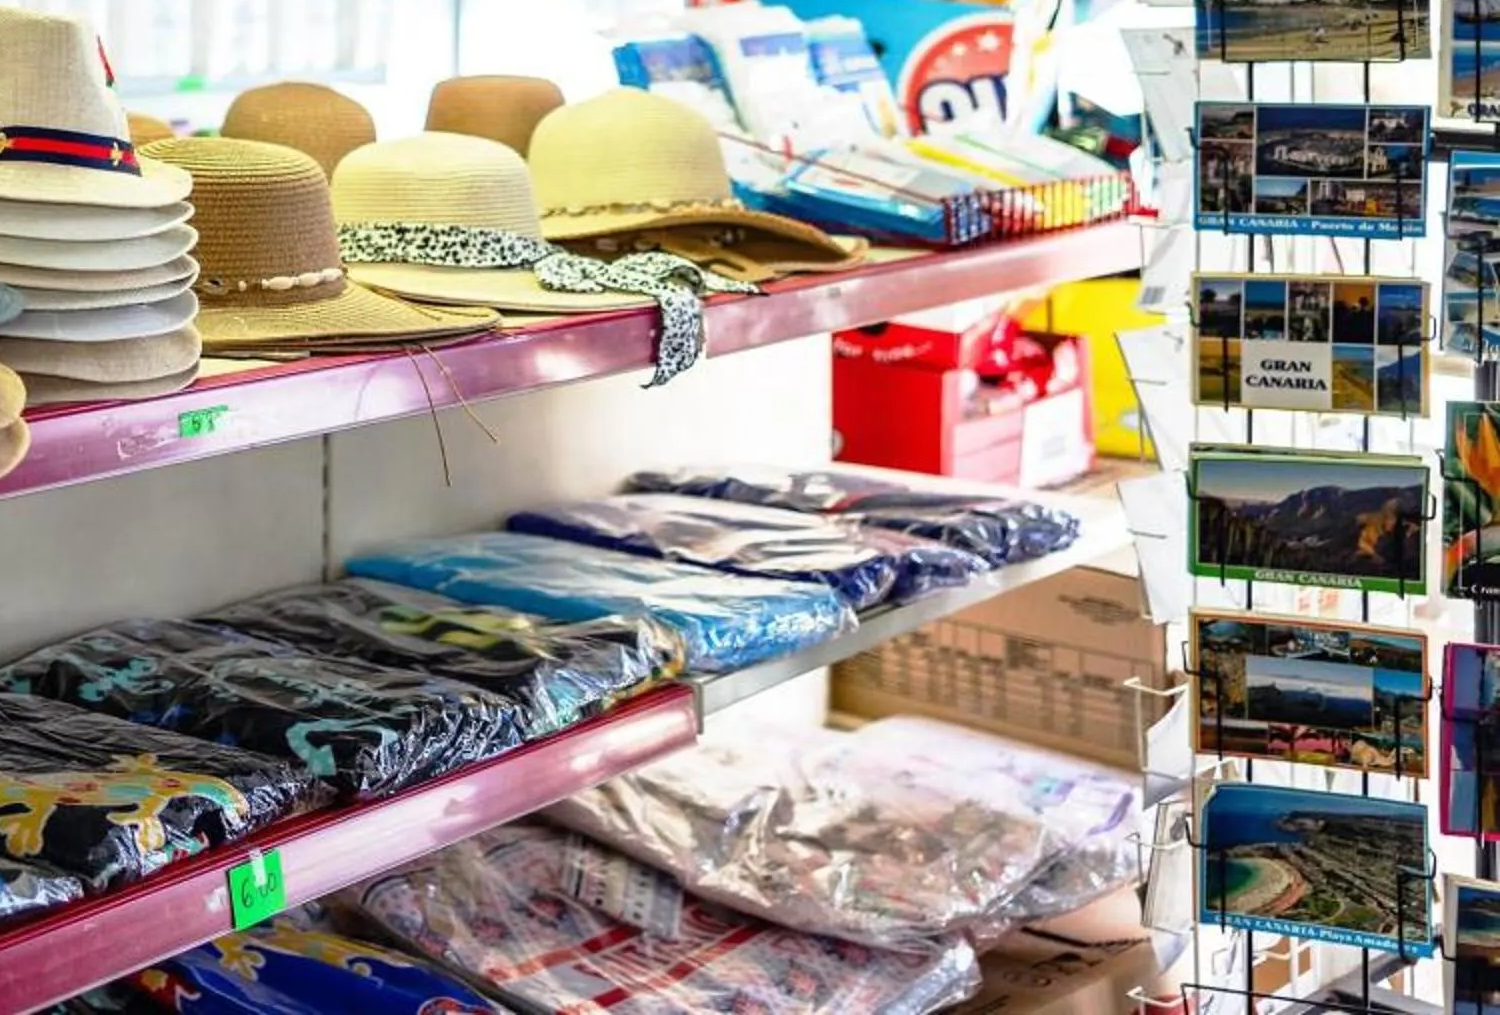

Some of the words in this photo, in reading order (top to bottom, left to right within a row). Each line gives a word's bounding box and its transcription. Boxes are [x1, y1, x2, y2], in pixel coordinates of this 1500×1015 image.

[1239, 216, 1300, 229] CANARIA
[1260, 358, 1312, 373] GRAN
[1245, 374, 1328, 391] CANARIA
[1254, 570, 1296, 582] GRAN
[1299, 573, 1363, 587] CANARIA
[1255, 920, 1315, 936] CANARIA
